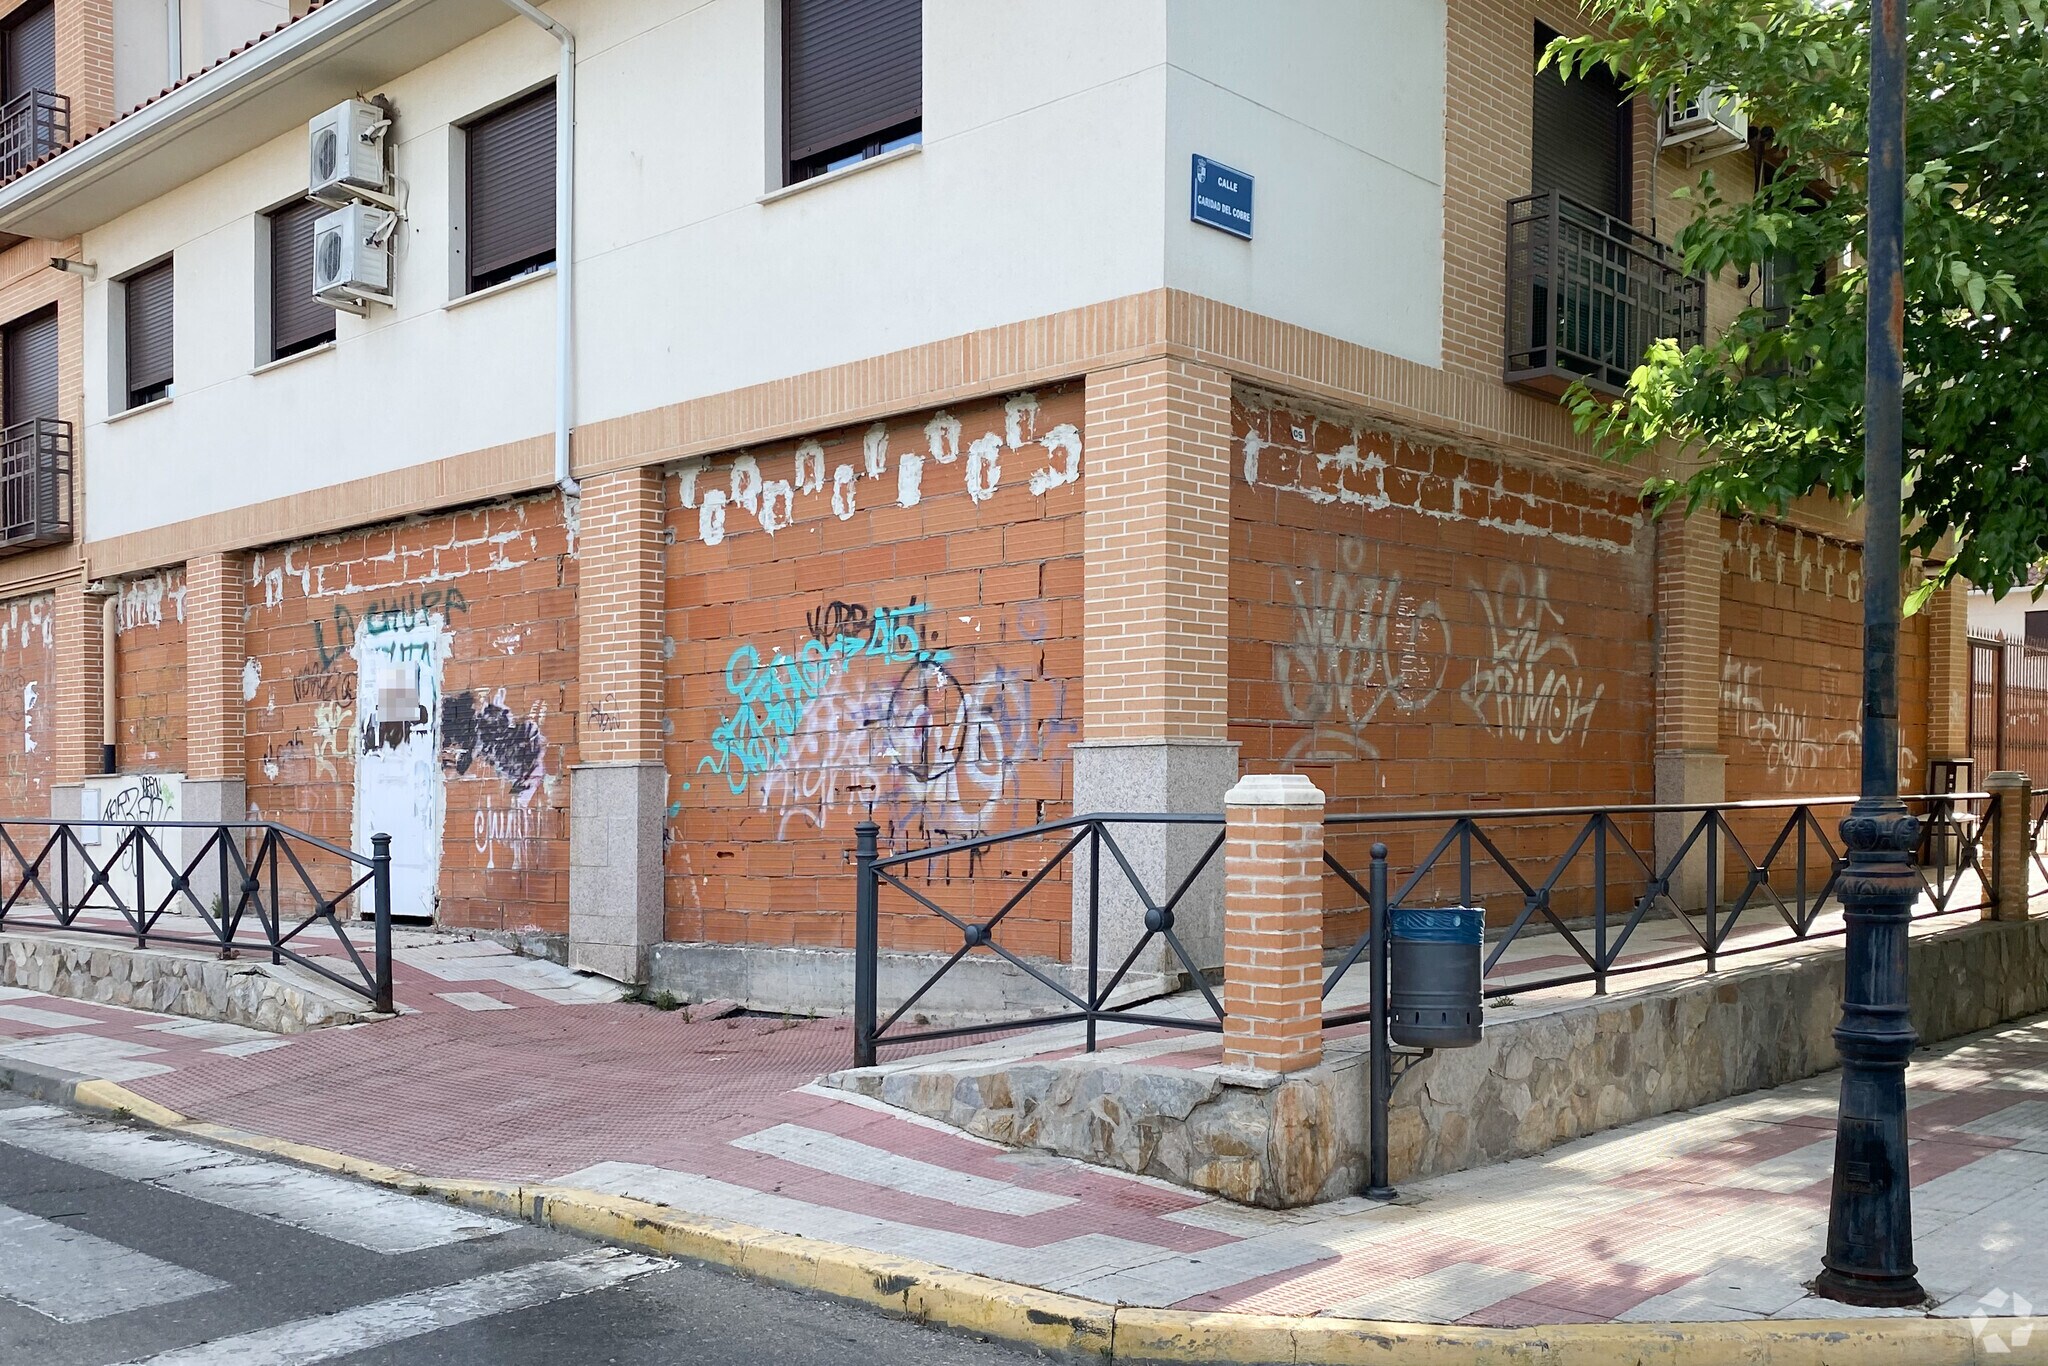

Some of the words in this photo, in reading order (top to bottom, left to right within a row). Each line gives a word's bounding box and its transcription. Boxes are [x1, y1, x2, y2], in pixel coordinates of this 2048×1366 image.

[1217, 177, 1238, 192] CALLE
[1198, 195, 1221, 211] CARIDAD
[1222, 204, 1231, 215] DEL
[1233, 208, 1250, 222] COBRE
